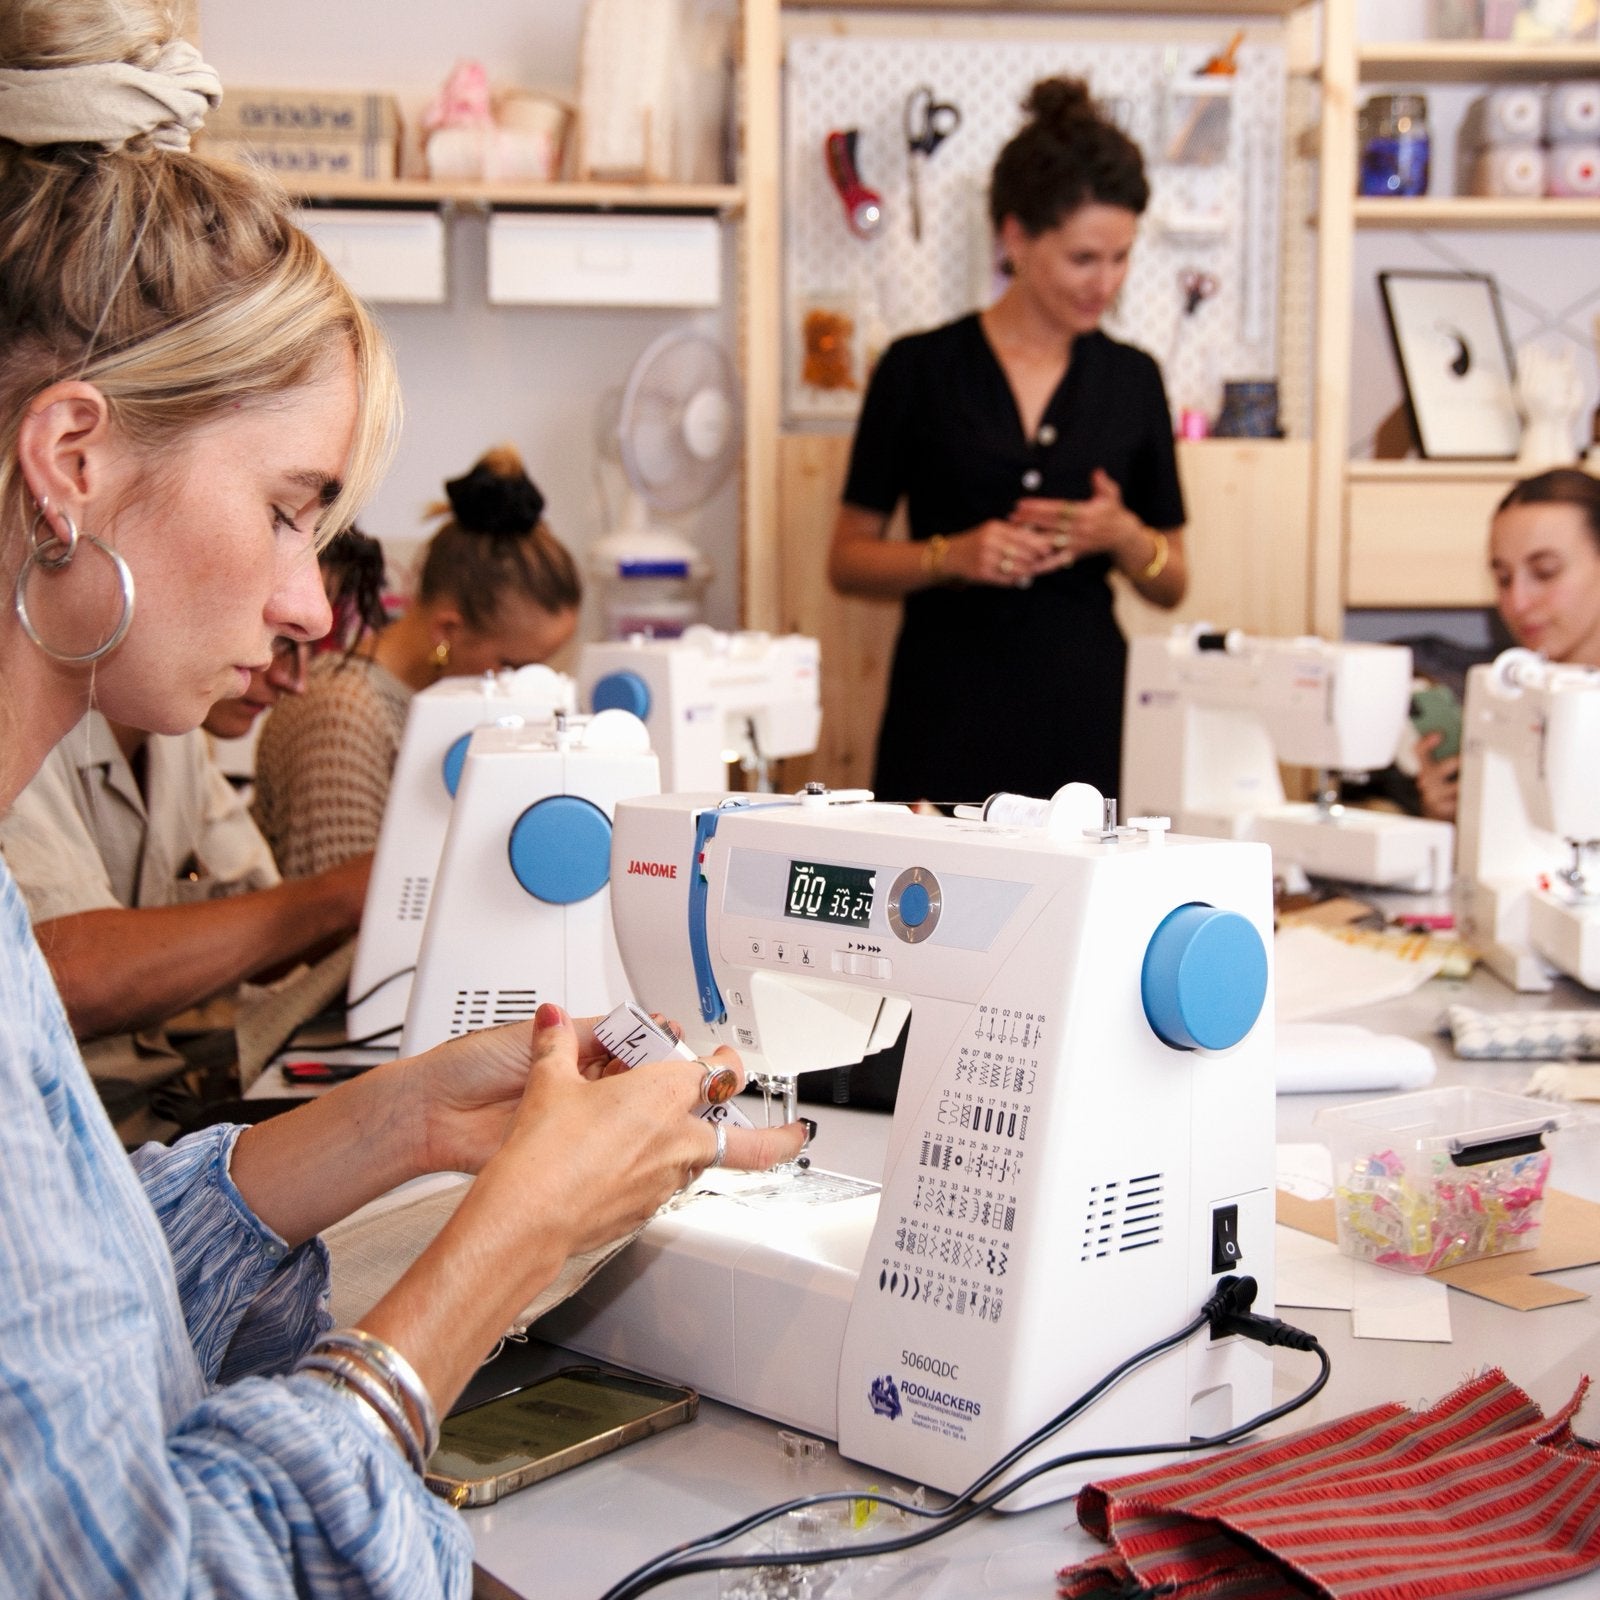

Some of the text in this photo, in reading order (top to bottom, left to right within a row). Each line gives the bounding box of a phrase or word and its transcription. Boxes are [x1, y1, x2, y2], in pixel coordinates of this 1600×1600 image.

[628, 860, 677, 878] JANOME
[790, 874, 826, 913] 00
[829, 895, 850, 918] 3.5
[626, 1034, 646, 1048] 7
[901, 1350, 959, 1380] 5060QDC
[901, 1380, 981, 1416] ROOIJACKERS
